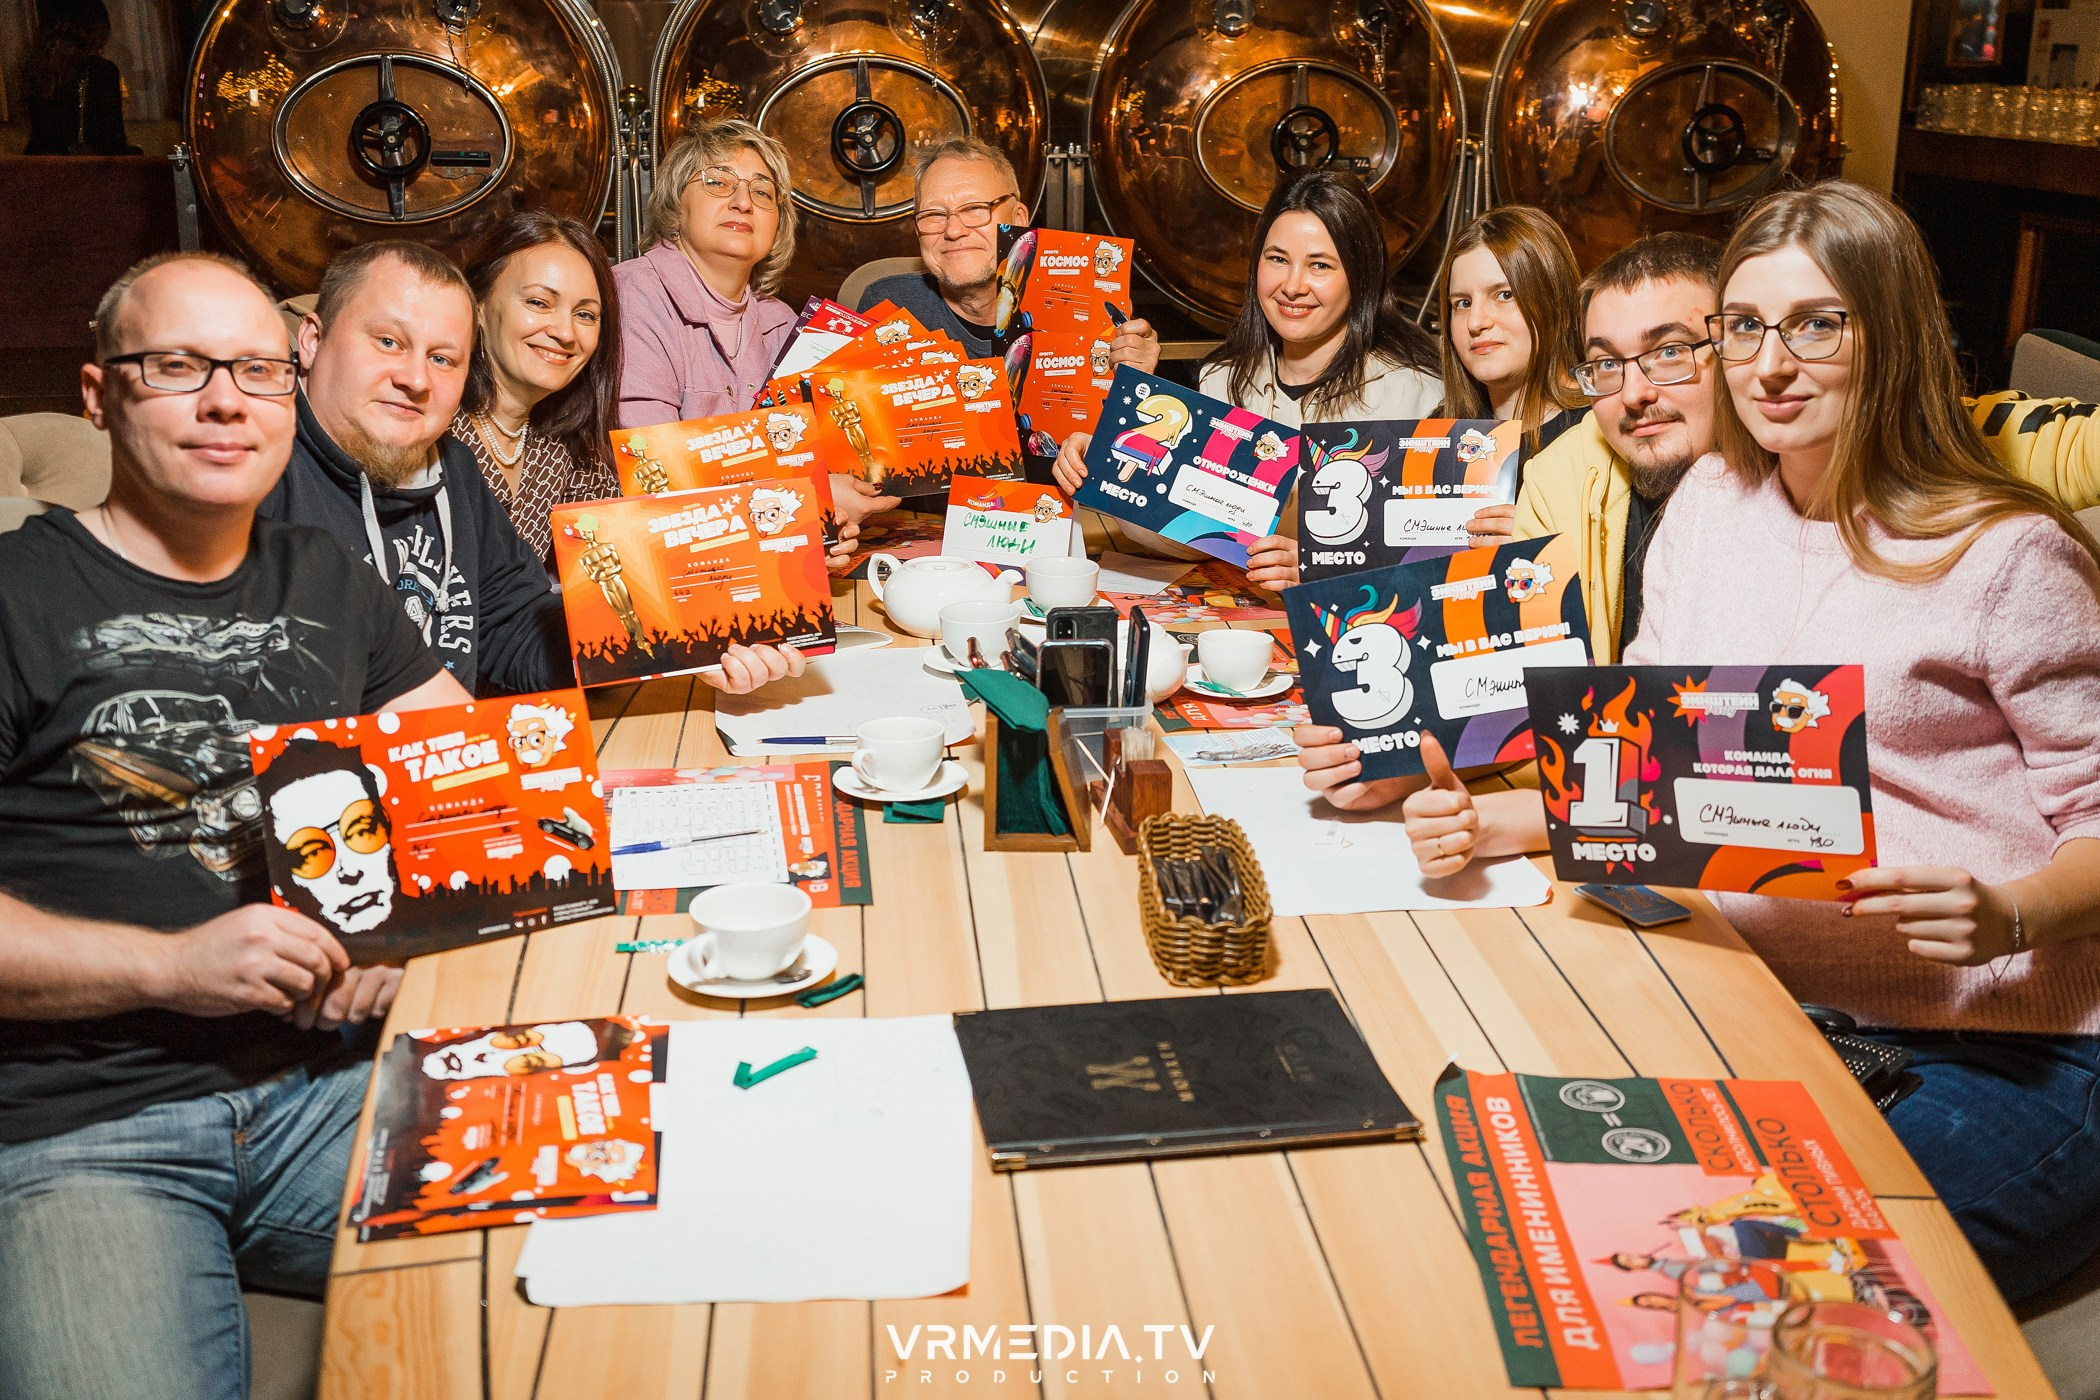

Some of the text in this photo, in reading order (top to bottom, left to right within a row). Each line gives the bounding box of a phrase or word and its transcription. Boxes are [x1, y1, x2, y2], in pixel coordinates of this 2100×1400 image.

[1040, 256, 1089, 268] КОСМОС
[1035, 356, 1085, 370] КОСМОС
[880, 376, 936, 396] ЗВЕЗДА
[892, 384, 955, 407] ВЕЧЕРА
[687, 427, 745, 451] ЗВЕЗДА
[700, 436, 766, 464] ВЕЧЕРА
[1192, 456, 1278, 494] ОТМОРОЖЕНКИ
[1100, 480, 1148, 508] МЕСТО
[1392, 486, 1412, 496] МЫ
[1414, 486, 1423, 494] В
[1424, 484, 1452, 494] ВАС
[648, 504, 722, 534] ЗВЕЗДА
[664, 514, 748, 548] ВЕЧЕРА
[688, 557, 730, 568] КОМАНДА
[1312, 552, 1366, 565] МЕСТО
[1436, 621, 1571, 658] МЫ В ВАС ВЕРИМ!
[388, 740, 426, 763] КАК
[1351, 730, 1420, 754] МЕСТО
[404, 740, 500, 783] ТАКОЕ
[1724, 750, 1796, 765] КОМАНДА,
[1692, 762, 1833, 780] КОТОРАЯ ДАЛА ОГНЯ
[1571, 842, 1657, 862] МЕСТО
[1446, 1094, 1487, 1167] АКЦИЯ
[1670, 1082, 1735, 1172] СКОЛЬКО
[1756, 1117, 1842, 1228] СТОЛЬКО
[1485, 1096, 1572, 1286] ИМЕНИННИКОВ
[1466, 1171, 1544, 1349] ЛЕГЕНДАРНАЯ
[1549, 1288, 1600, 1351] ДЛЯ
